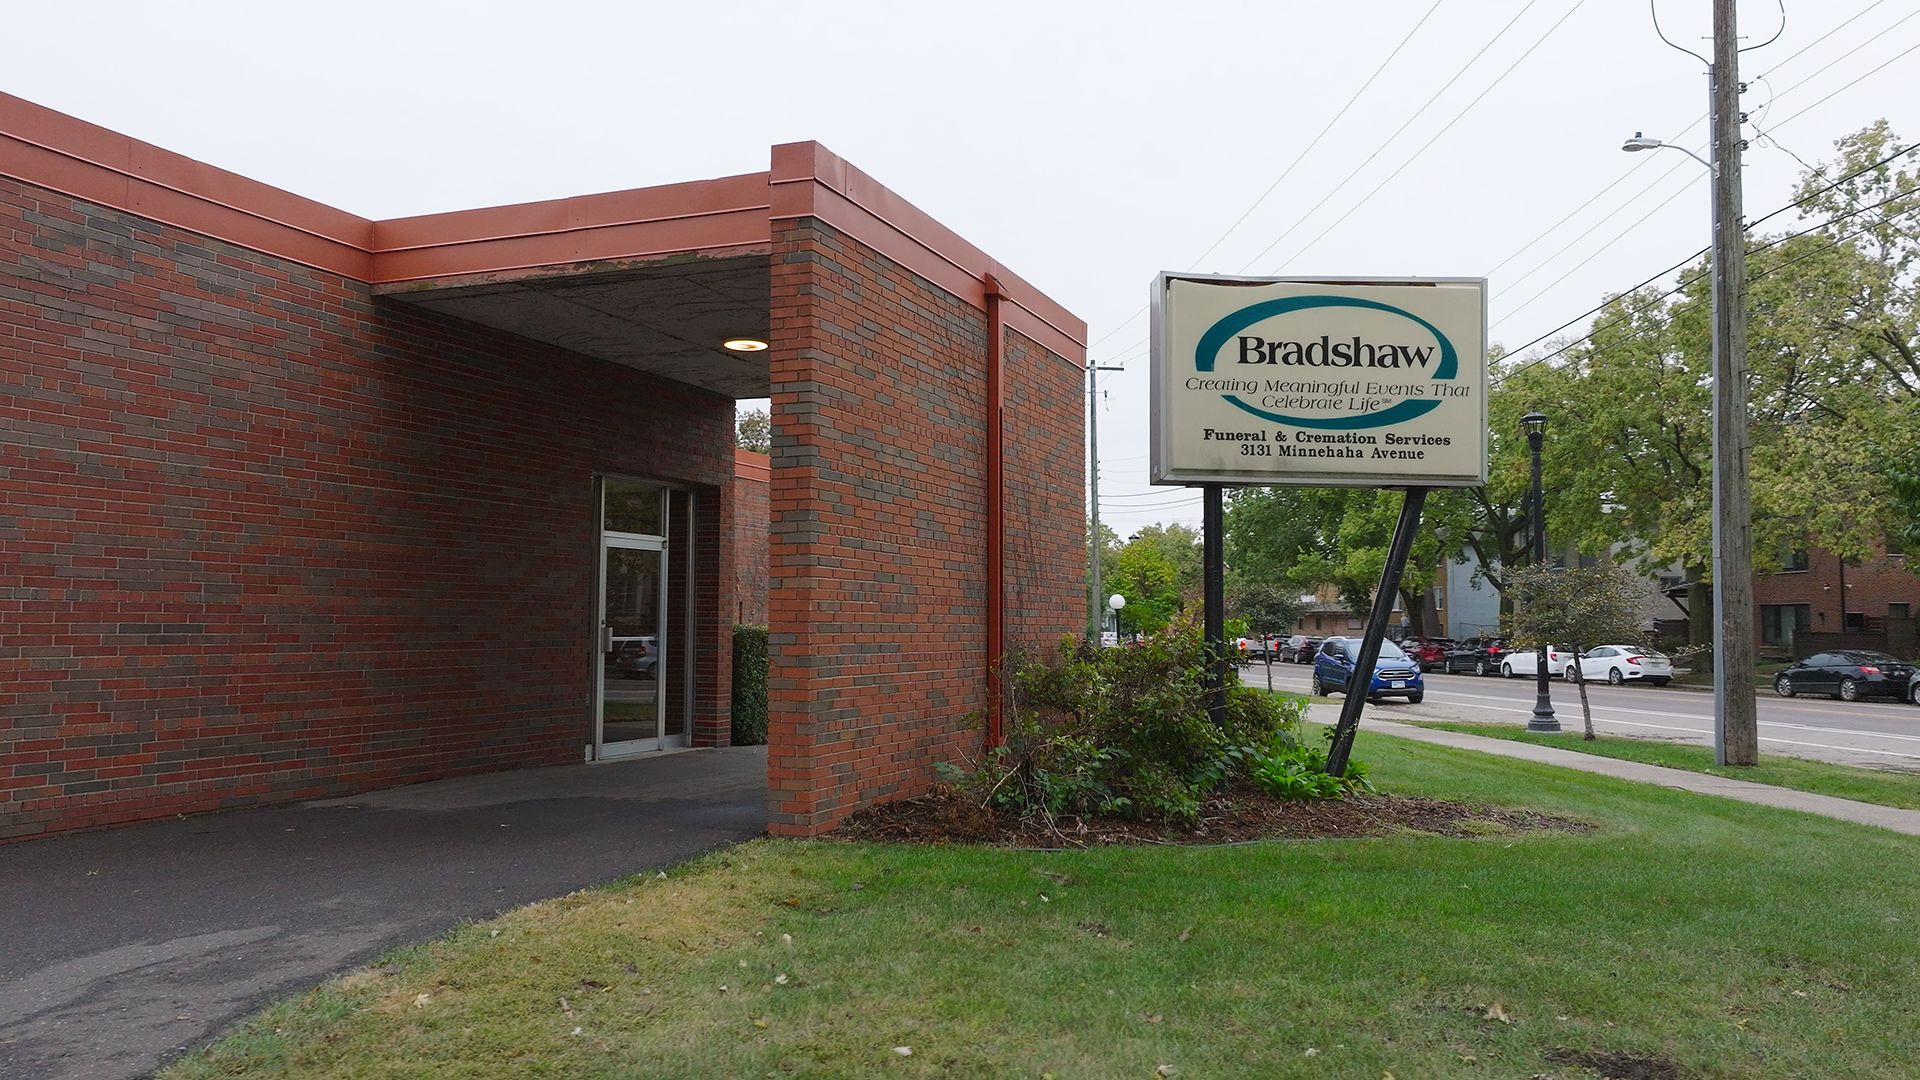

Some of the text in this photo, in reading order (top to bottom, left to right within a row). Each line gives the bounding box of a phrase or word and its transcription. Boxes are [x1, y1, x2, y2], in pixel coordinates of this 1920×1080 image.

[1236, 335, 1435, 369] Bradshaw
[1185, 376, 1470, 397] Creating Meaningful Events That
[1261, 394, 1342, 410] Celebrate
[1203, 428, 1451, 446] Funeral & Cremation Services
[1240, 443, 1425, 460] 3131 Minnehaha Avenue
